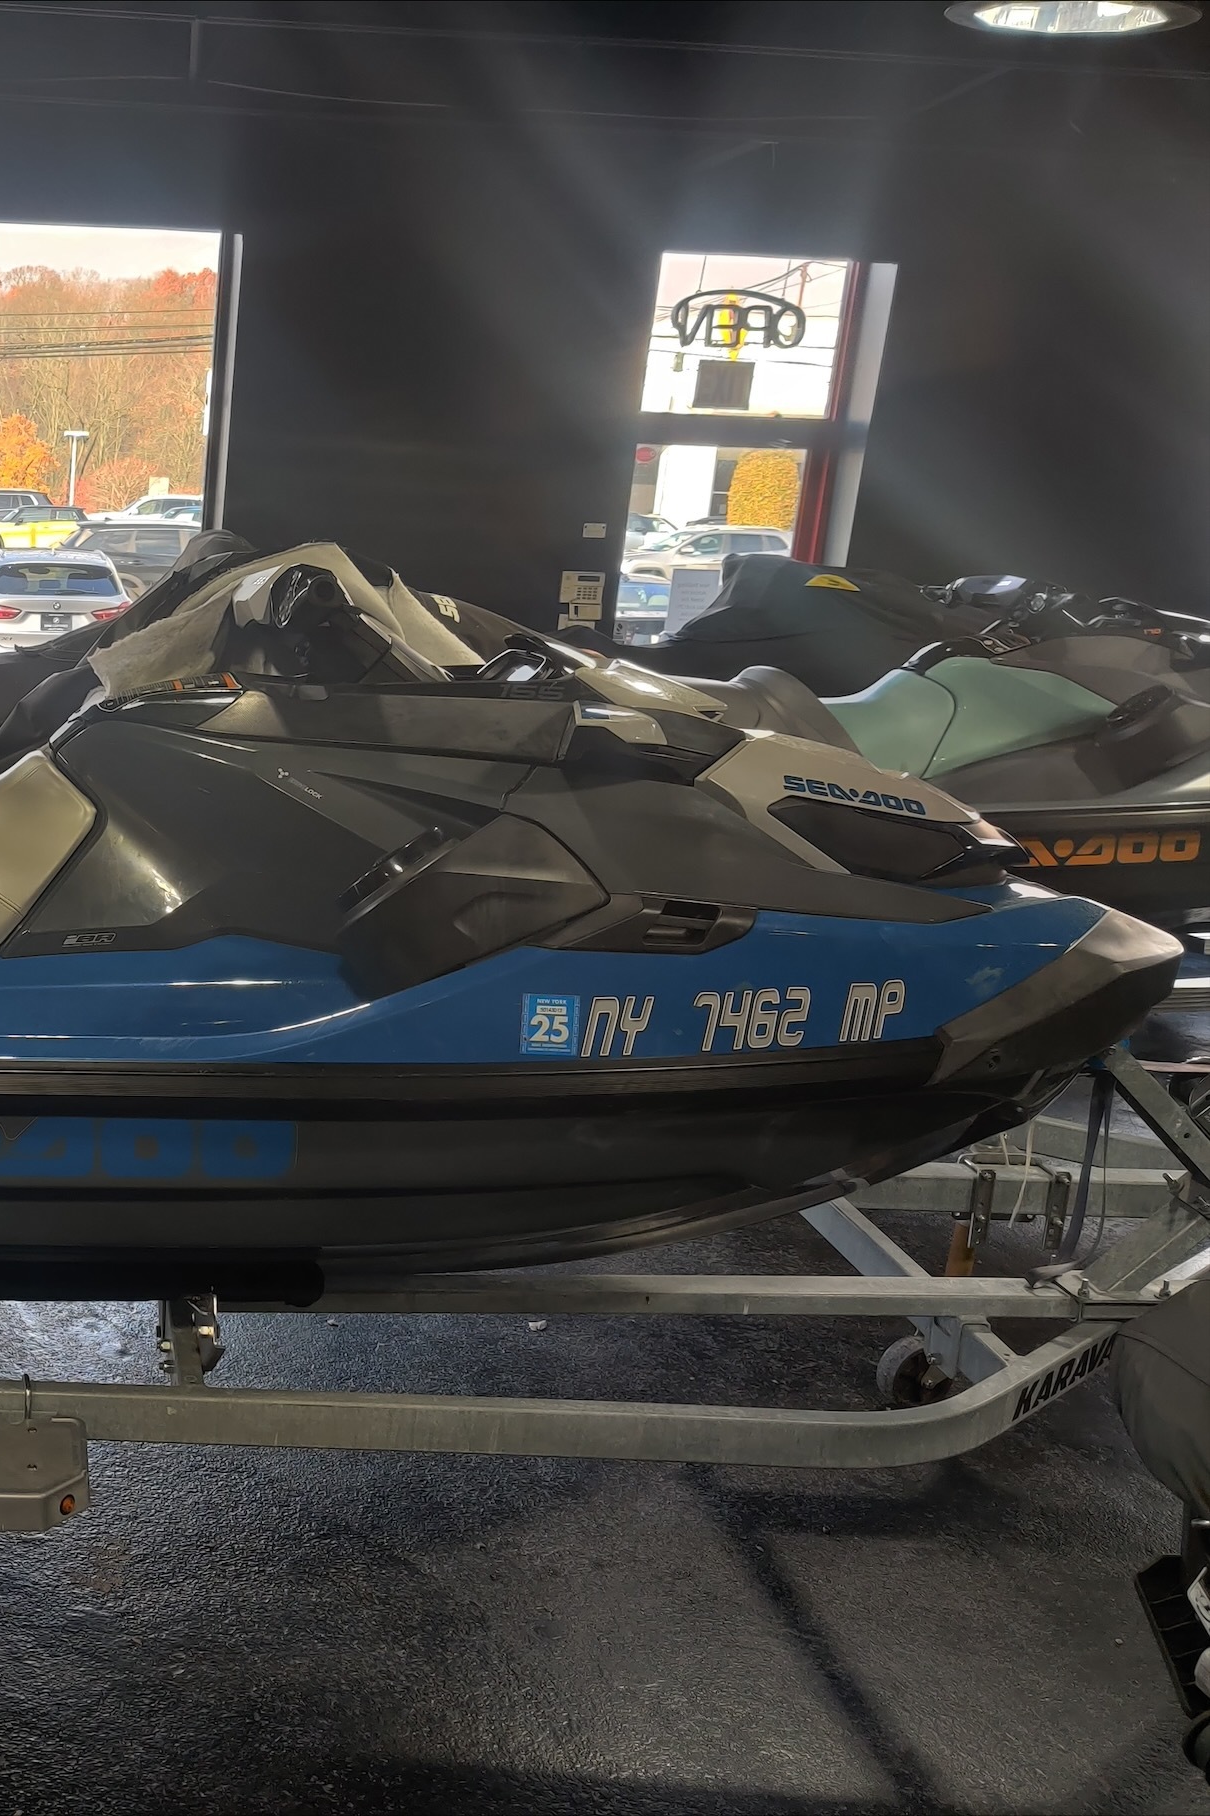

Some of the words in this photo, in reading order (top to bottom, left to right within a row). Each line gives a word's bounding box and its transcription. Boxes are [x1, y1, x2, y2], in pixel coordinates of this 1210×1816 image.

[530, 1014, 569, 1043] 25
[580, 996, 655, 1057] NY
[693, 986, 811, 1052] 7462
[839, 979, 906, 1043] MP
[1012, 1330, 1118, 1422] KARAVA
